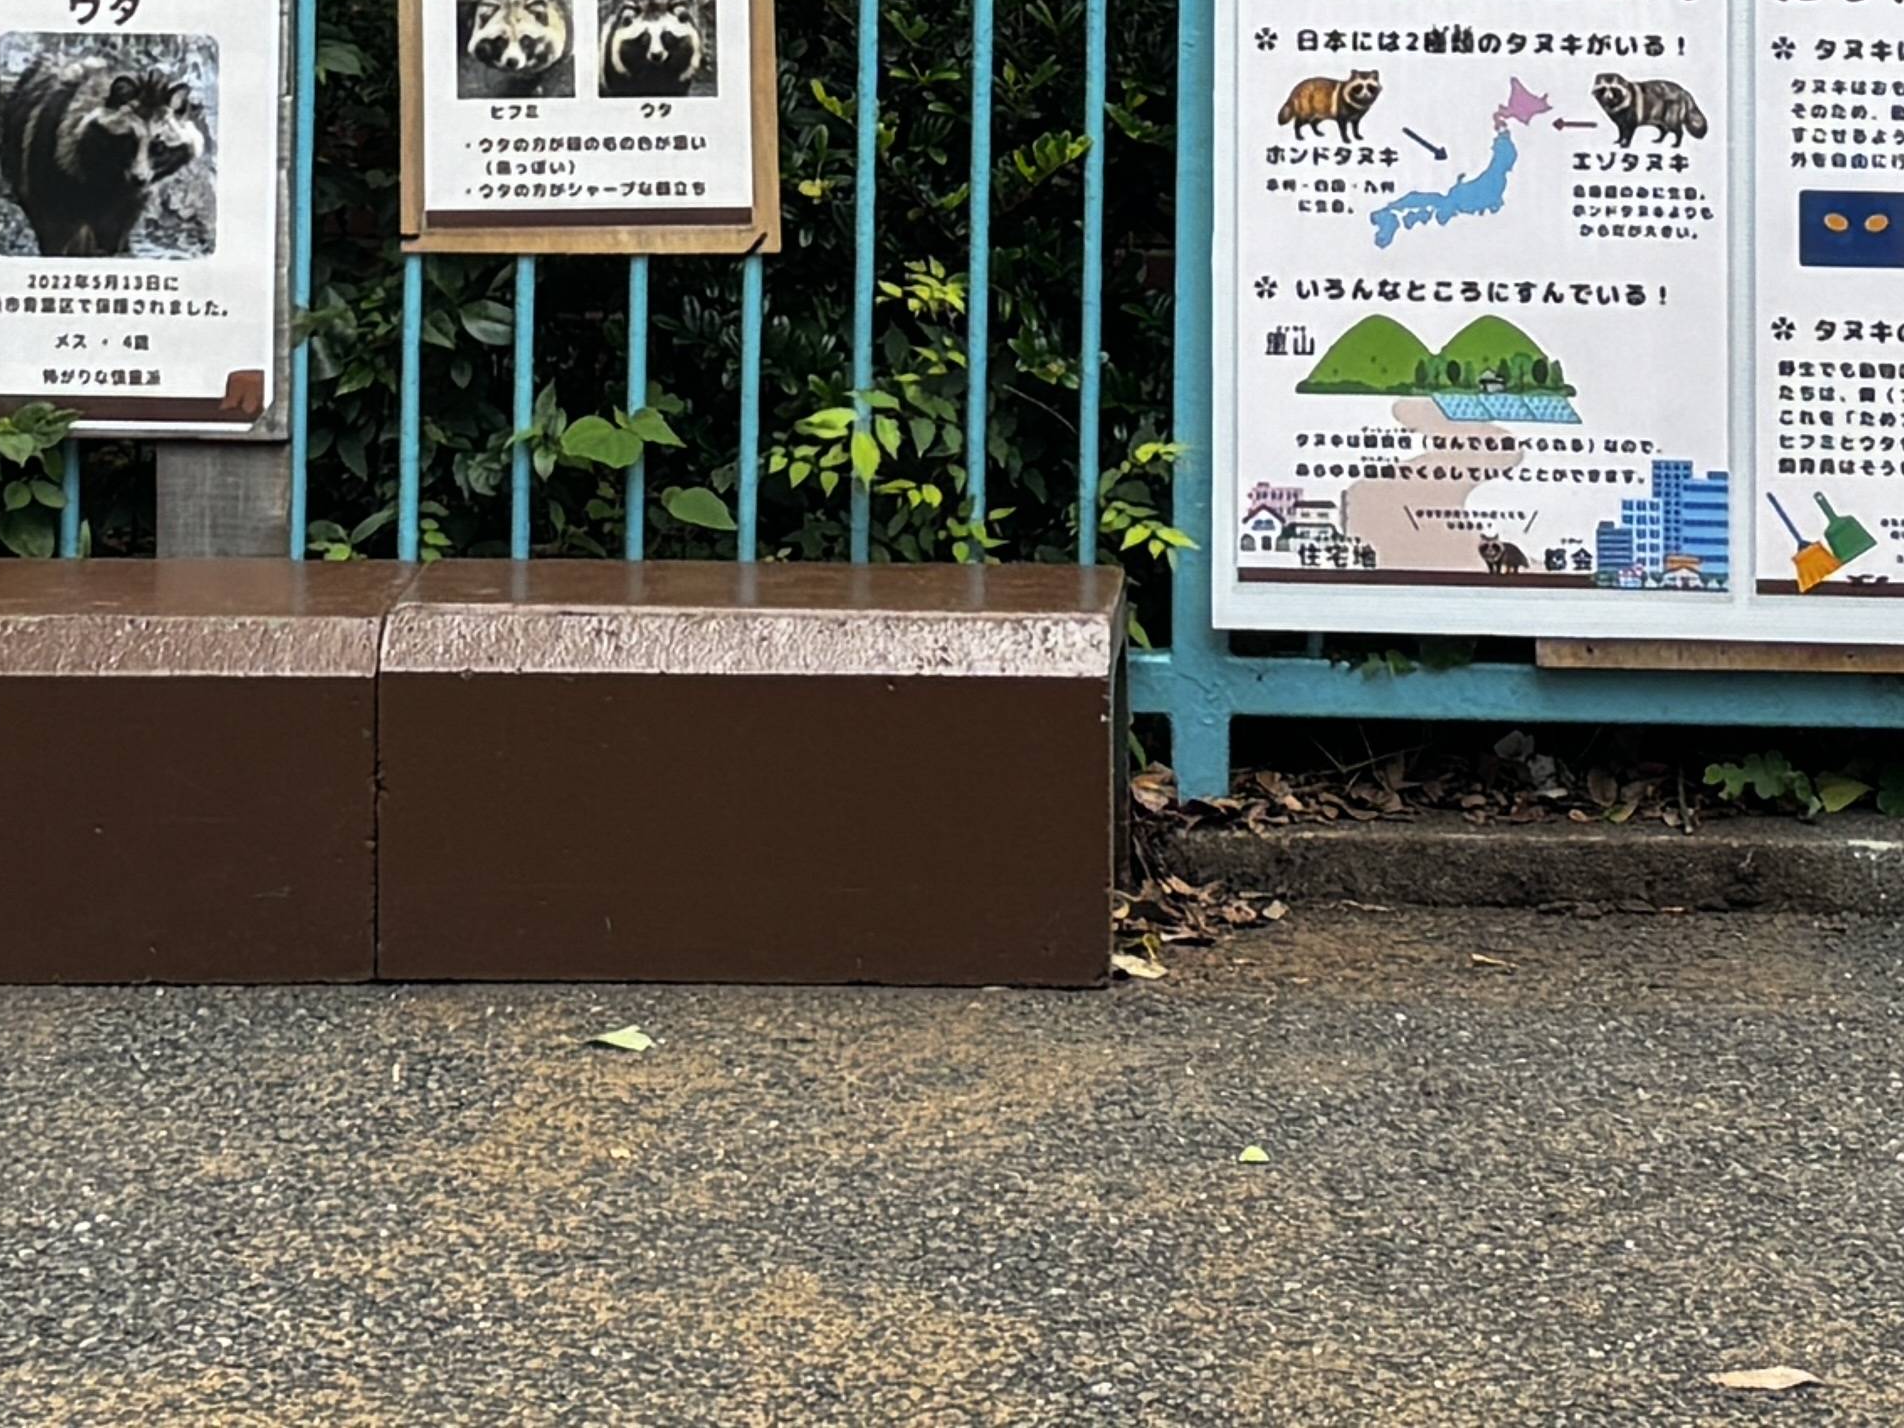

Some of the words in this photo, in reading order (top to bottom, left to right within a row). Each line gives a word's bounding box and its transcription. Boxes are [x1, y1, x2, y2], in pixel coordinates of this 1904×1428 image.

[490, 104, 539, 120] ヒフミ
[640, 102, 672, 118] ウタ
[1266, 145, 1398, 167] ホンドタヌキ
[1572, 153, 1690, 173] エゾタヌキ
[26, 274, 179, 292] 2022年5月13日に
[1295, 278, 1670, 307] いろんなところにすんでいる！
[1298, 544, 1377, 568] 住宅地
[1544, 548, 1593, 570] 都会
